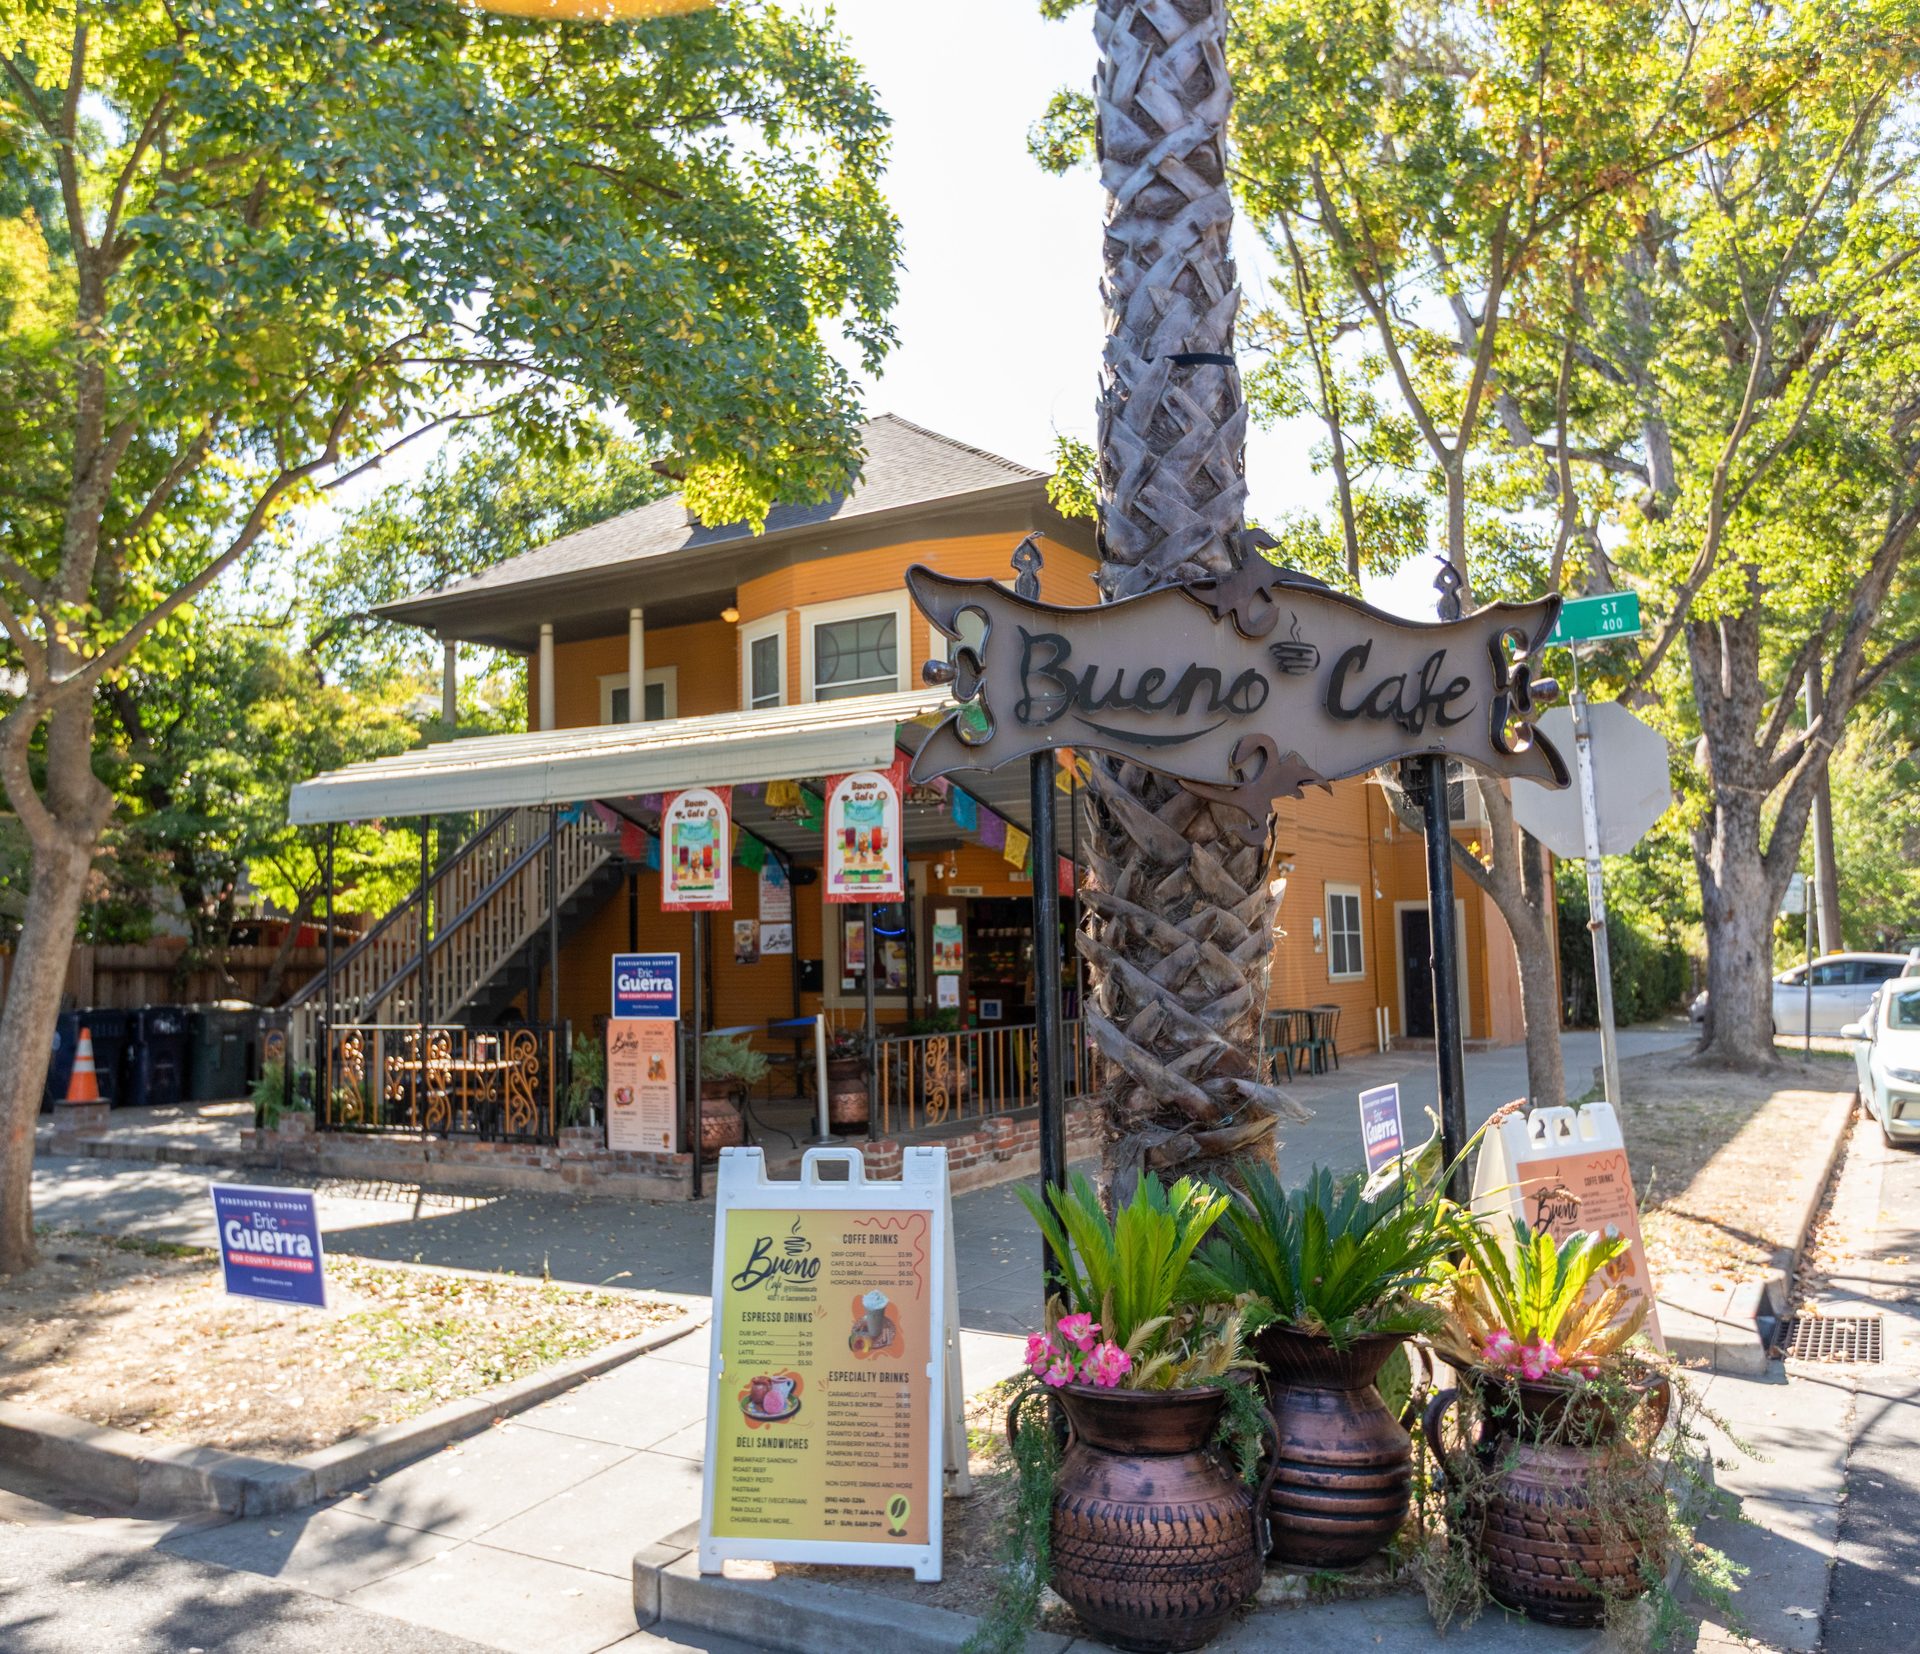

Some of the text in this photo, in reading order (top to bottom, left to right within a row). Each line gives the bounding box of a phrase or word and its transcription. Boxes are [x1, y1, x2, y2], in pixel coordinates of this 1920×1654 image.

[1601, 602, 1617, 616] ST
[1602, 617, 1623, 630] 400
[1014, 624, 1477, 736] Bueno Cafe
[851, 781, 877, 791] Bueno
[684, 799, 708, 808] Bueno
[638, 968, 653, 978] Eric
[617, 974, 674, 992] Guerra
[1366, 1118, 1398, 1146] Guerra
[219, 1196, 308, 1212] FIREFIGHTERS SUPPORT
[253, 1211, 278, 1231] Eric
[225, 1220, 313, 1257] Guerra
[843, 1234, 898, 1244] COFFE DRINKS
[230, 1253, 313, 1271] FOR COUNTY SUPERVISOR
[731, 1236, 821, 1292] Bueno
[742, 1312, 813, 1323] ESPRESSO DRINKS
[829, 1371, 910, 1384] ESPECIALTY DRINKS
[736, 1437, 809, 1450] DELI SANDWICHES
